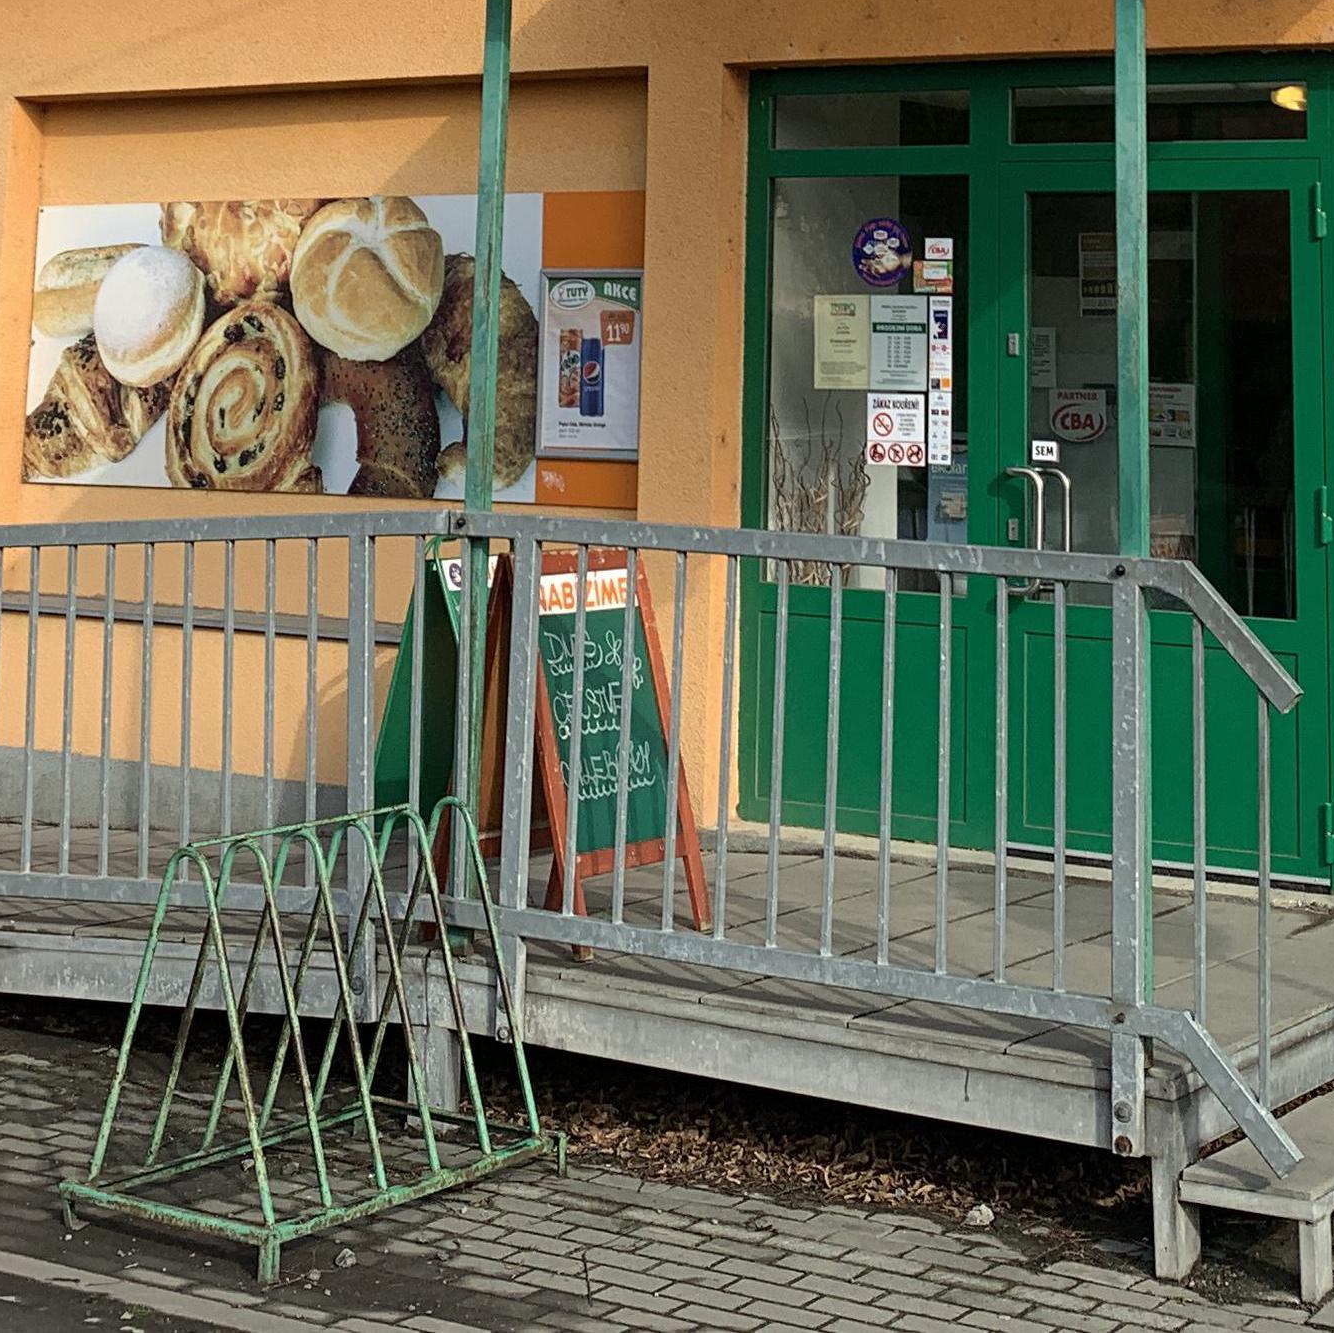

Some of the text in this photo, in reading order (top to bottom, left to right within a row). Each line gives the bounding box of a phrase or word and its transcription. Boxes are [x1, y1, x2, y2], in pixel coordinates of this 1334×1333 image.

[566, 286, 588, 298] TUTY
[603, 281, 637, 301] AKCE
[1056, 392, 1099, 402] PARTNER
[1060, 413, 1096, 431] CBA
[1035, 445, 1054, 457] SEM
